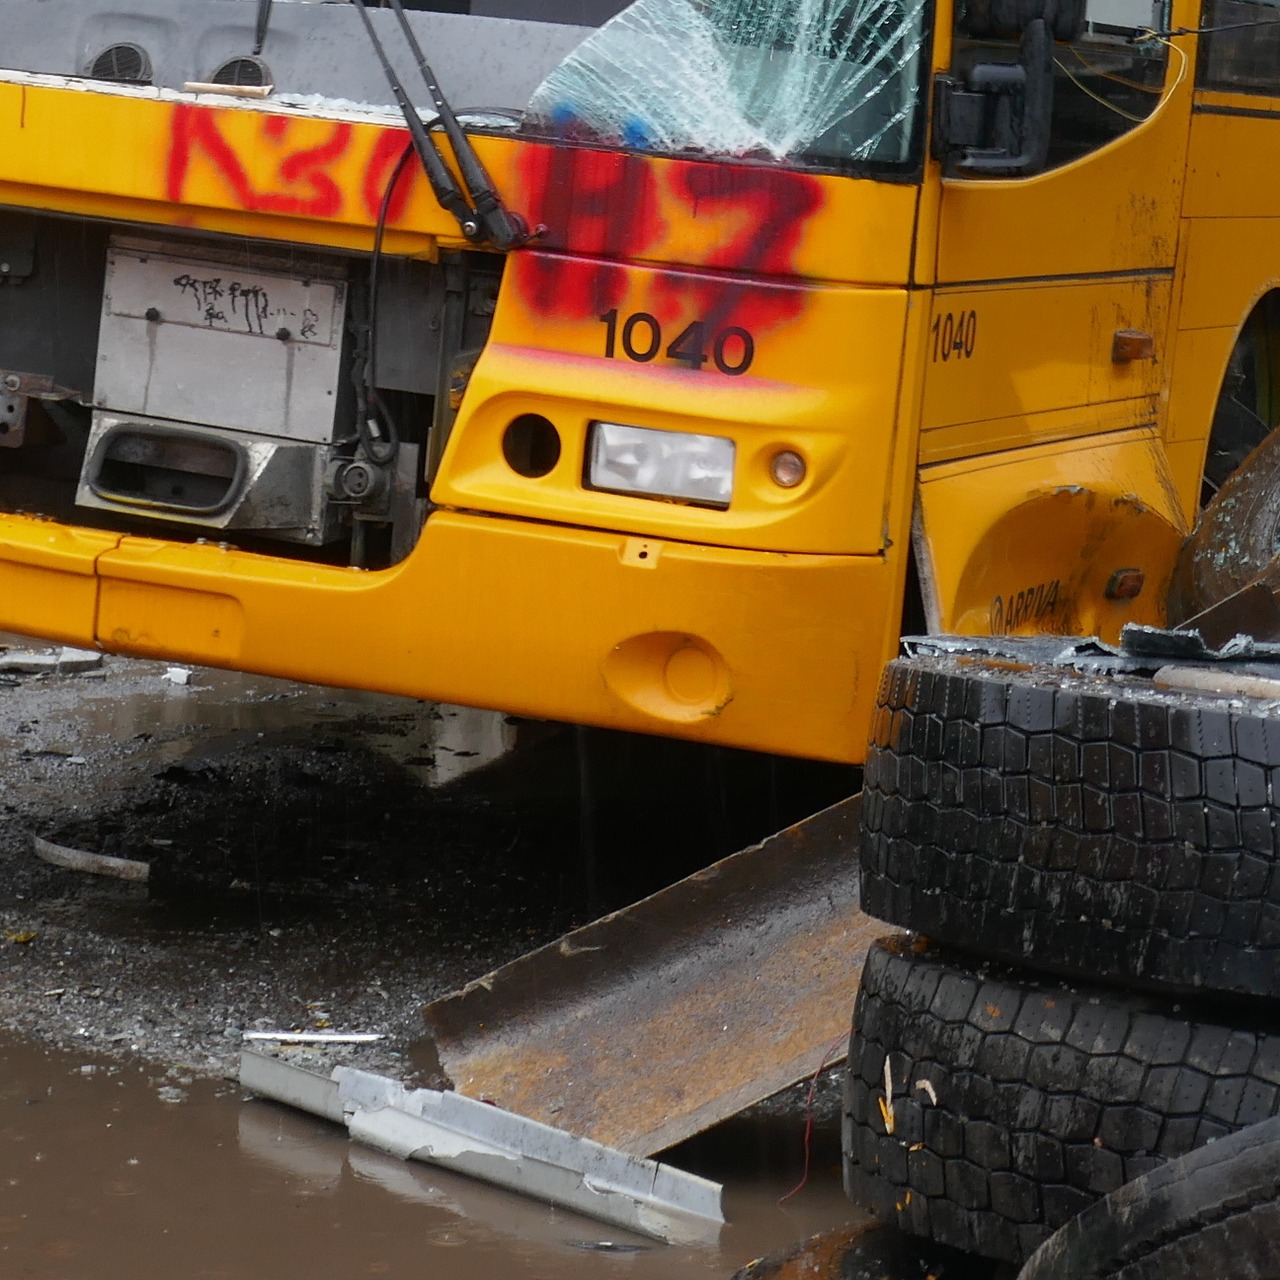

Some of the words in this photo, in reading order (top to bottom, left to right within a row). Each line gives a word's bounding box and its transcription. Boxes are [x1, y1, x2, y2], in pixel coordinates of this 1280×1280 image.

[599, 308, 755, 377] 1040
[932, 310, 977, 363] 1040
[1004, 579, 1061, 636] ARRIVA
